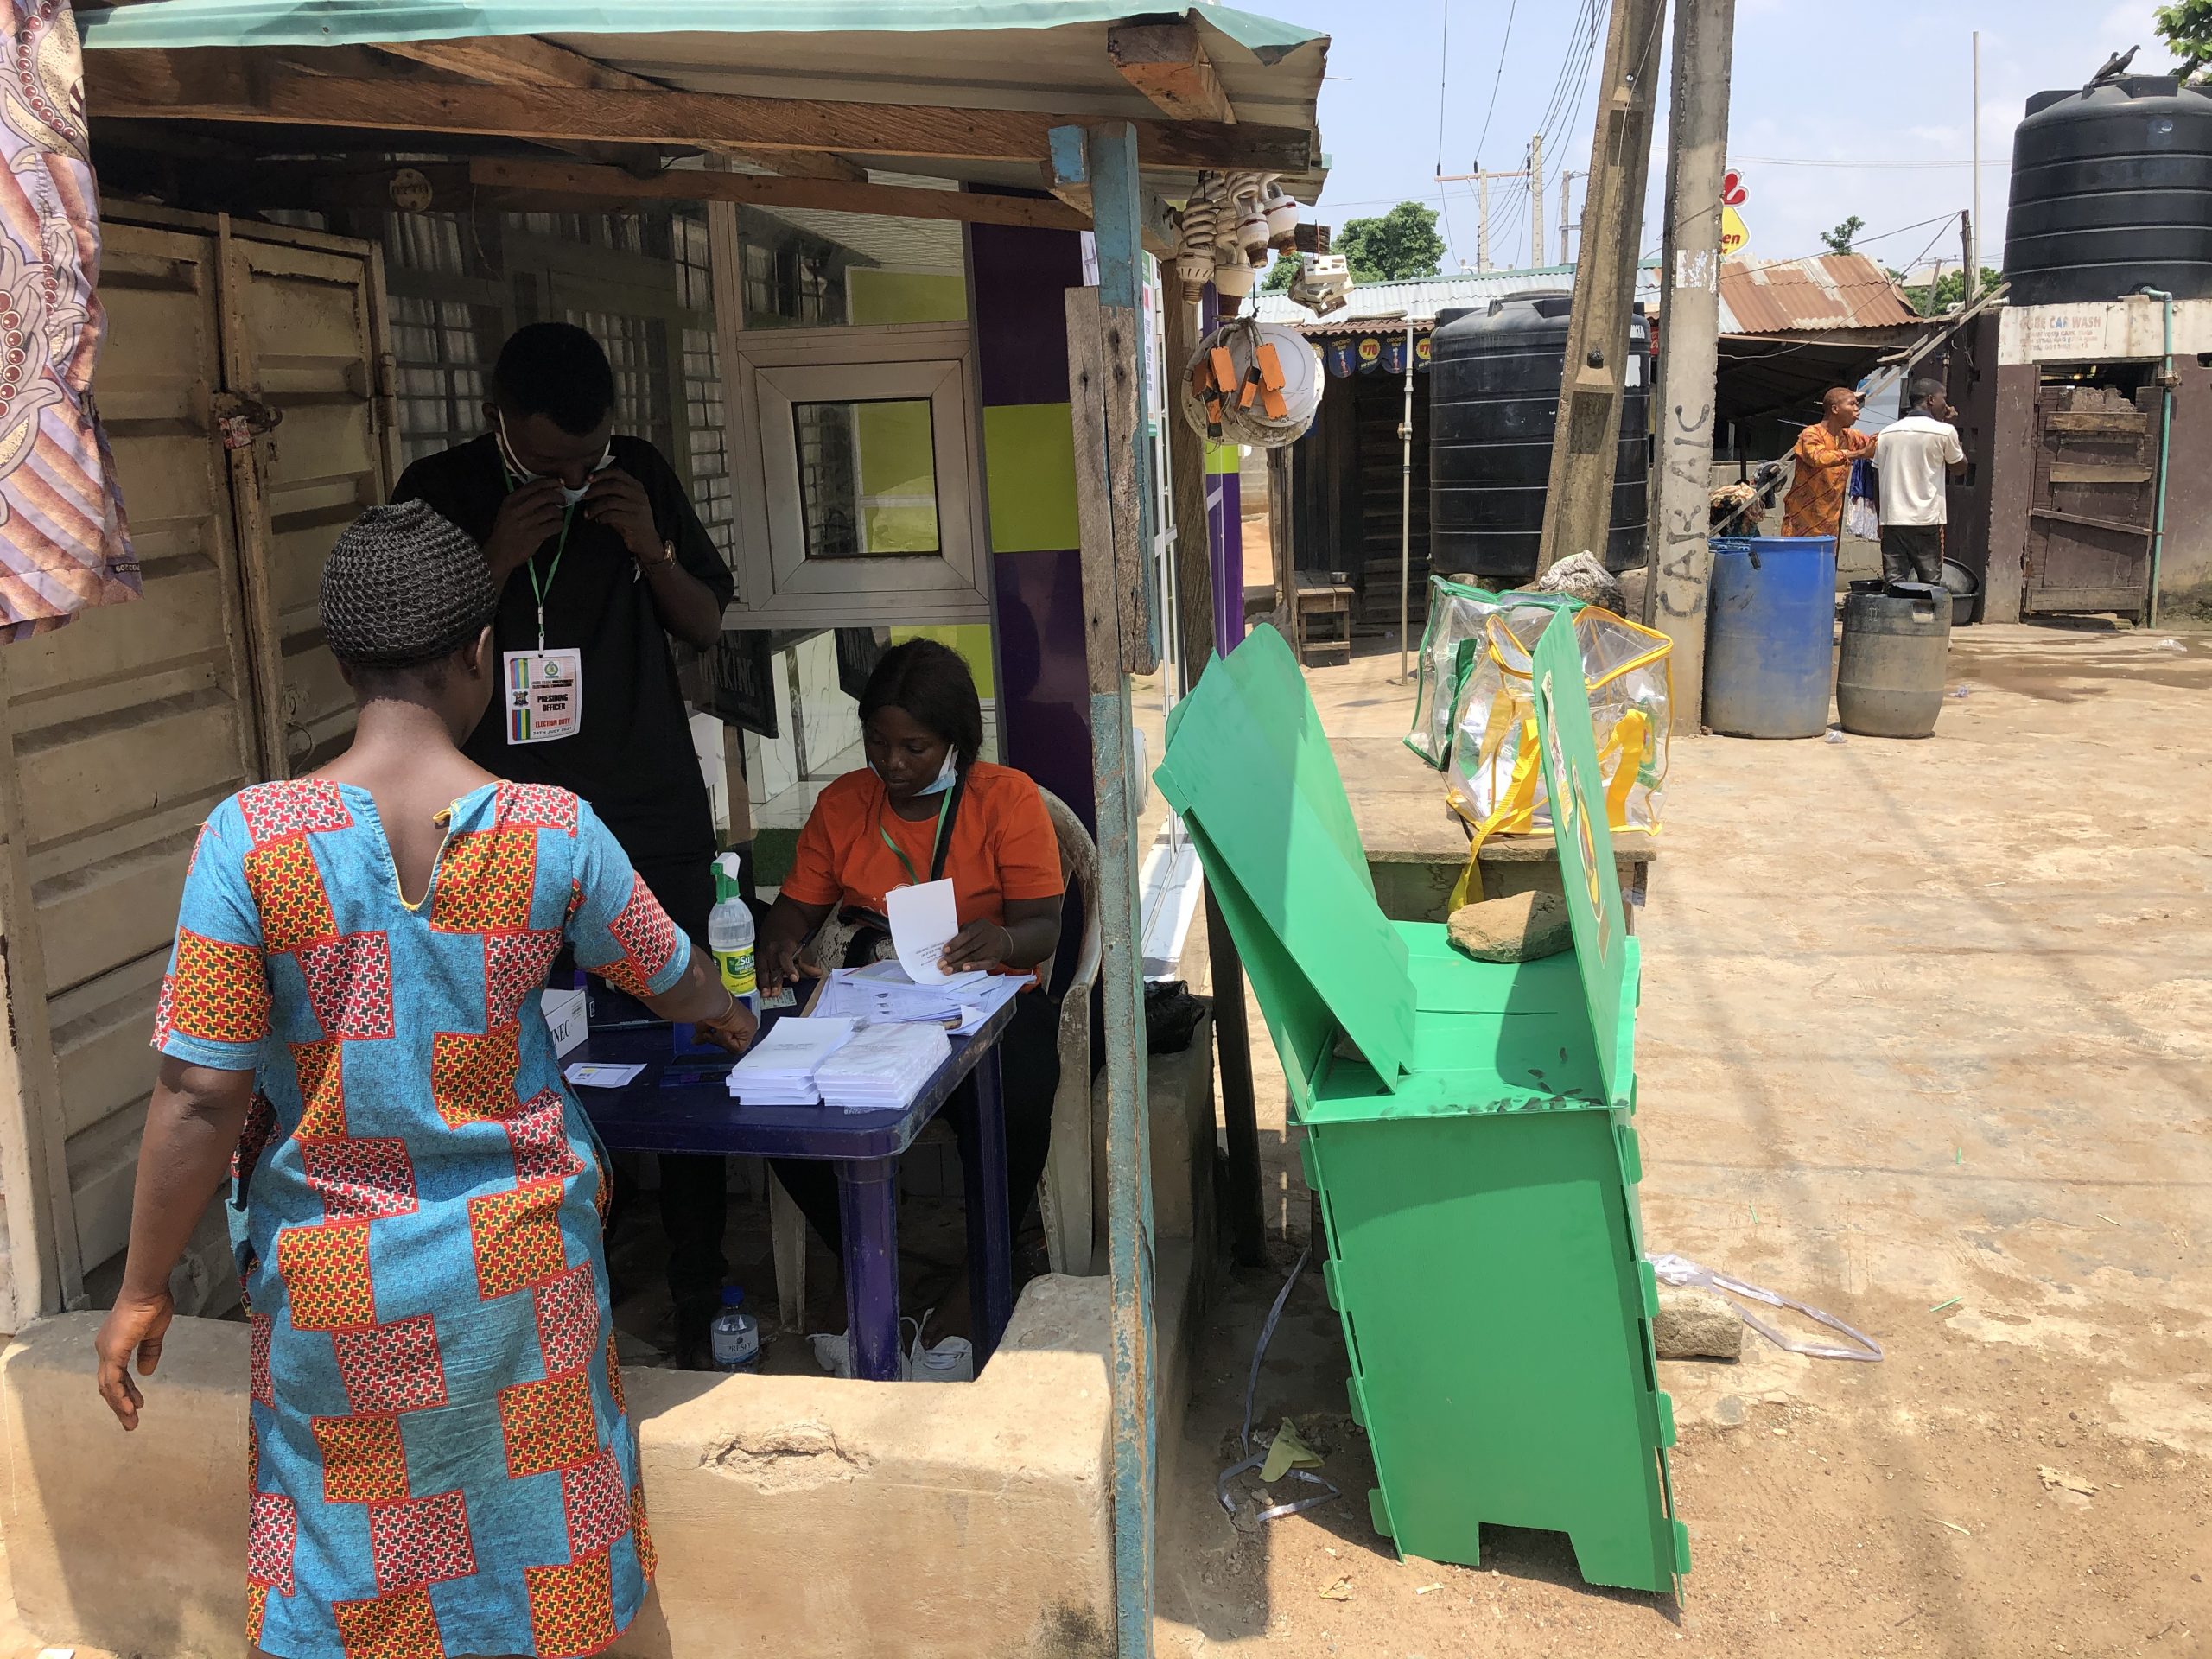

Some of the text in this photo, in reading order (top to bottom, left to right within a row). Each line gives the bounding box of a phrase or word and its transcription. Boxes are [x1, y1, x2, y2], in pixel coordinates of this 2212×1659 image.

[2072, 316, 2101, 328] WASH
[537, 694, 569, 703] PRESIDING
[542, 702, 566, 712] OFFICER
[535, 718, 571, 728] ELECTION DUTY
